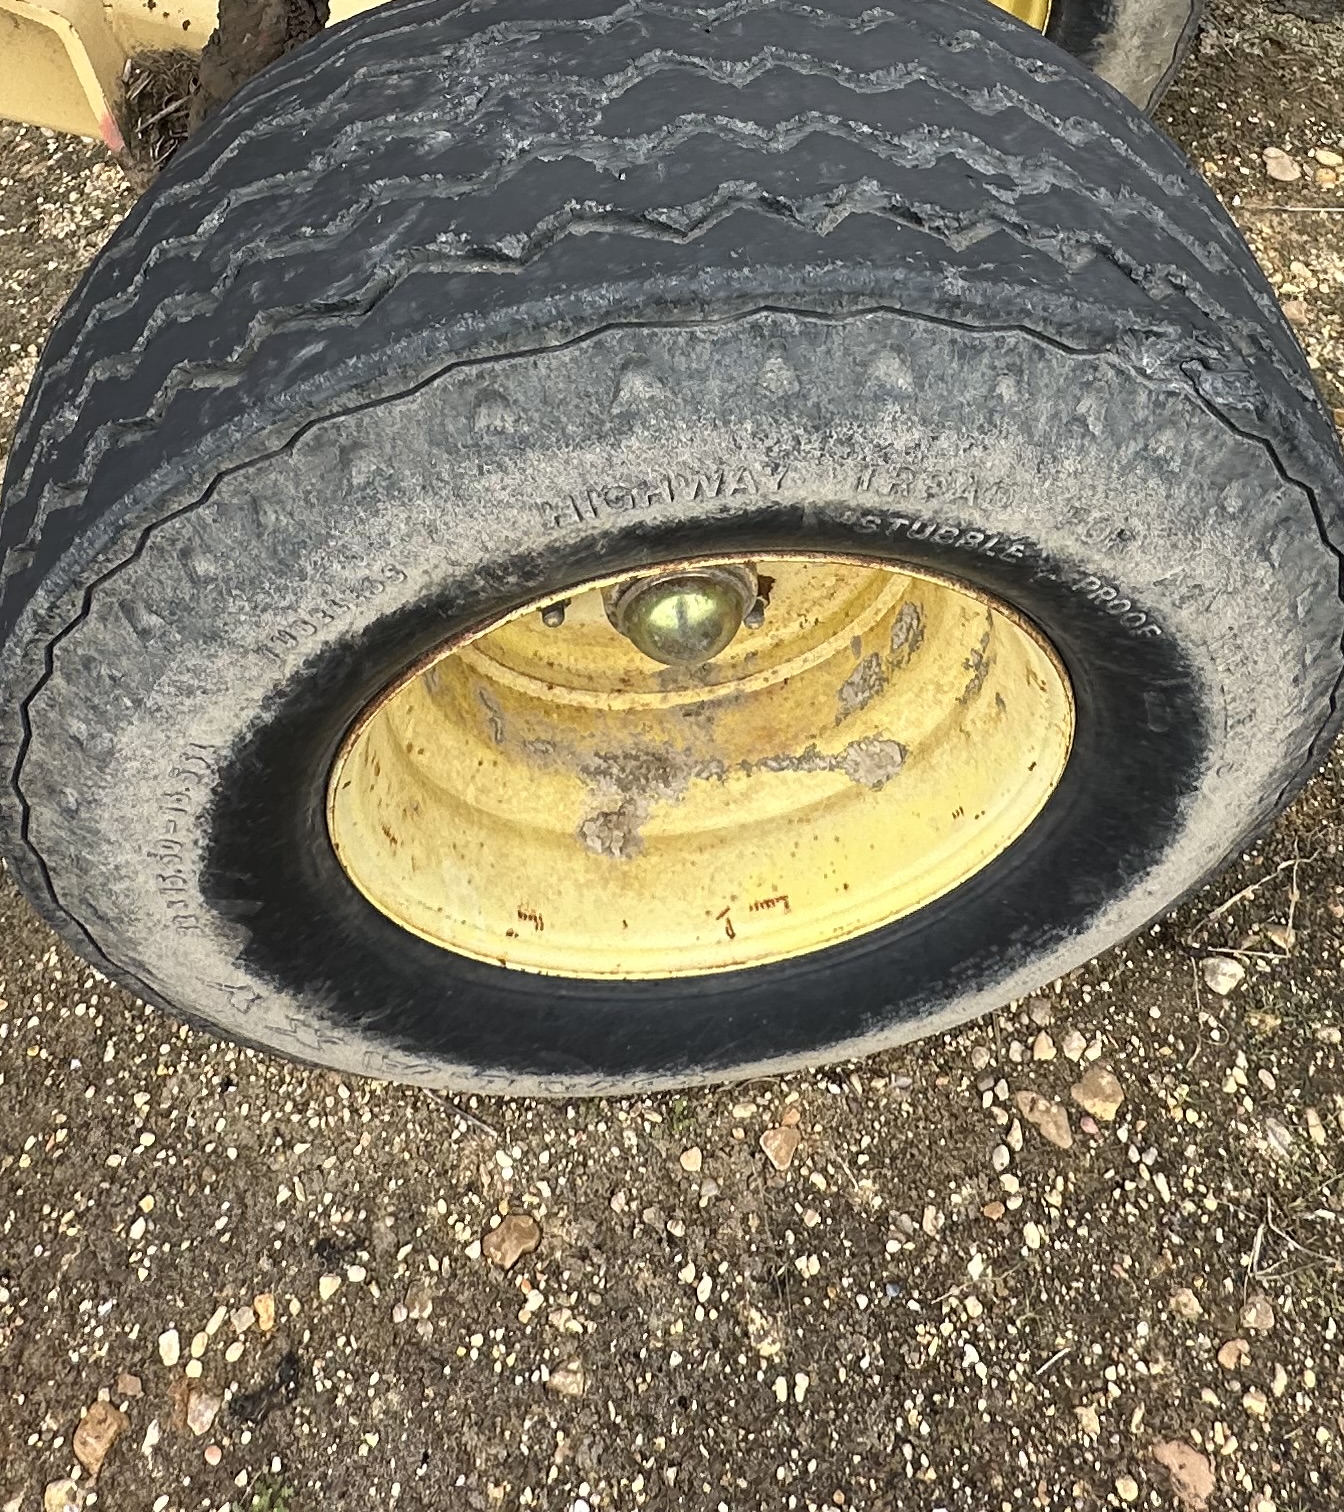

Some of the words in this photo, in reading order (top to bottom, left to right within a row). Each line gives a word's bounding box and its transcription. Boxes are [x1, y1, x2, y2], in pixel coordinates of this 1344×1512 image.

[543, 463, 791, 527] HIGHWAY
[858, 515, 1026, 563] STUBBLE
[1072, 575, 1163, 638] PROOF
